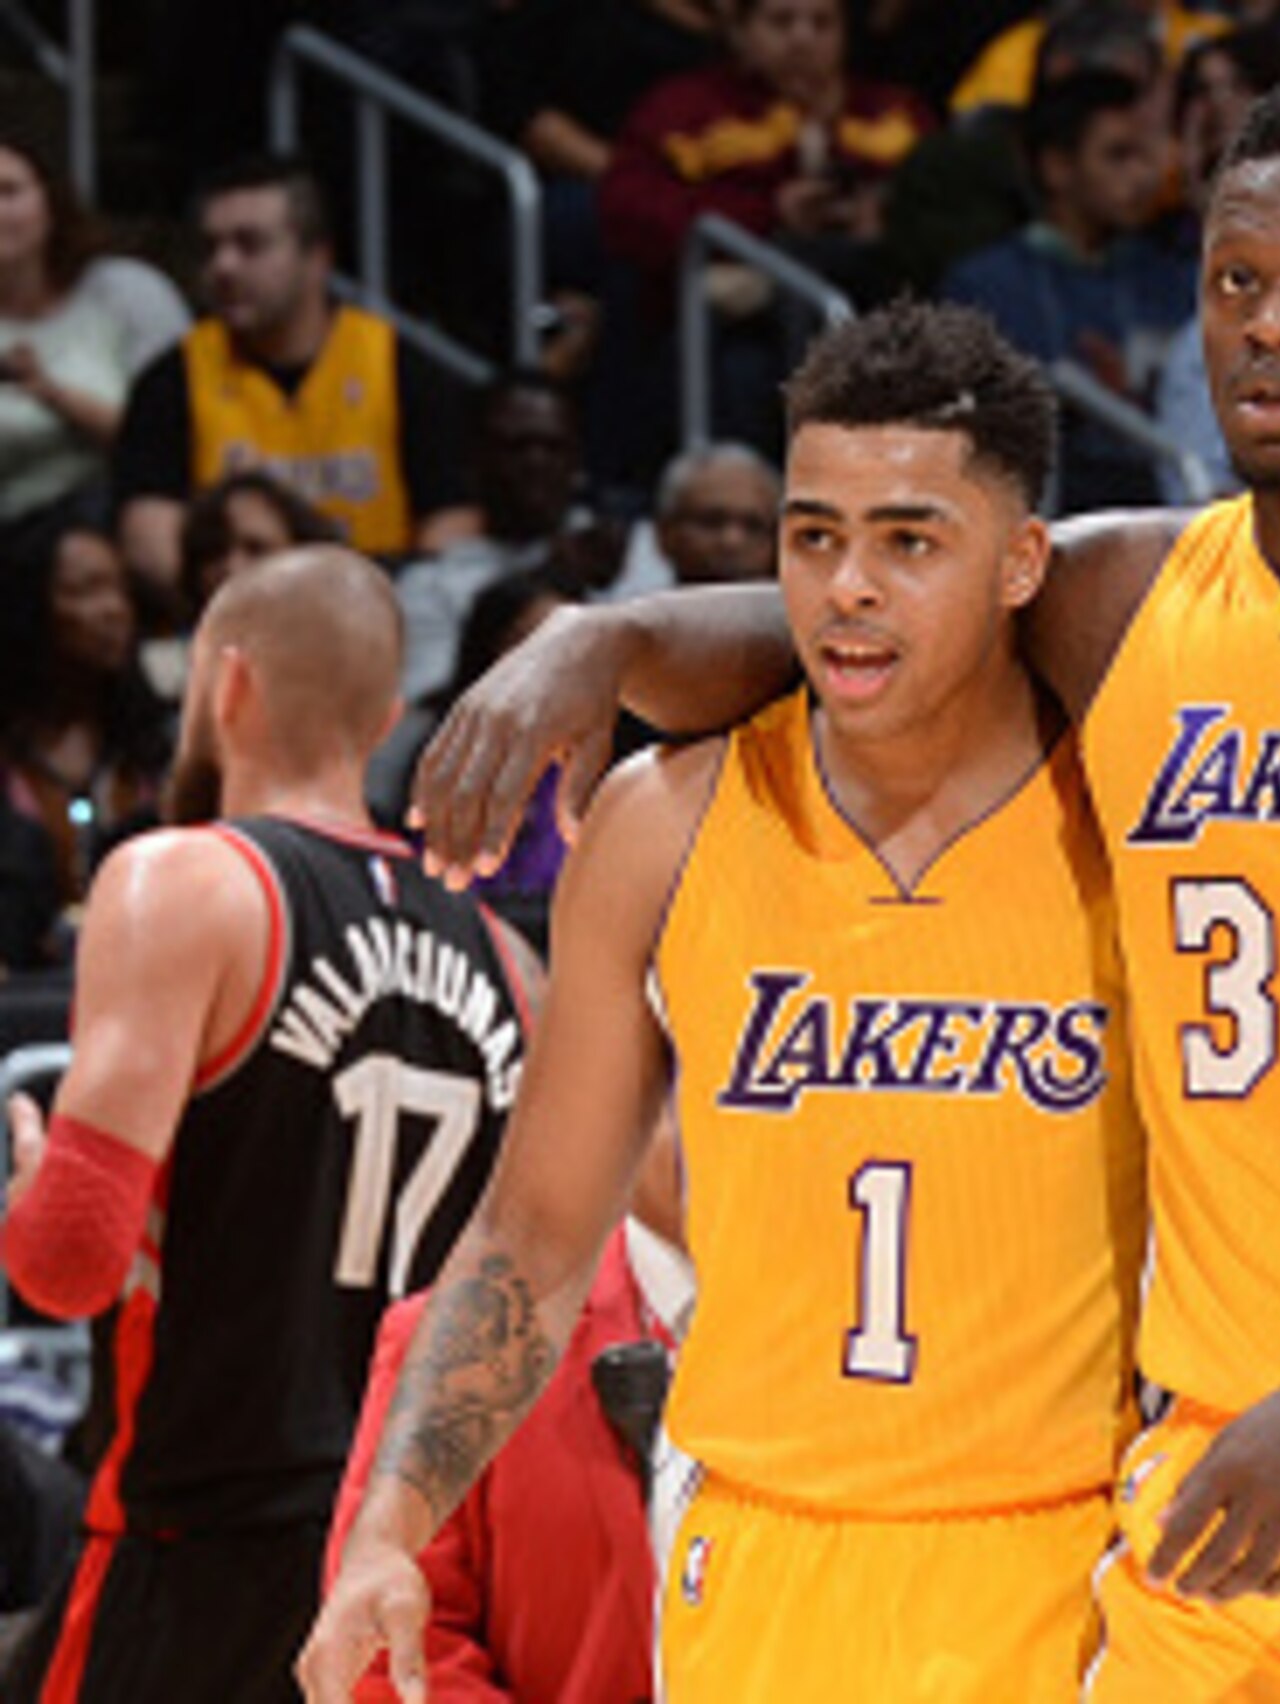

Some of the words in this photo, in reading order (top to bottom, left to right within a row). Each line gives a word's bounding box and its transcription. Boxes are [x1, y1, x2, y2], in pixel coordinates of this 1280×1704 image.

[716, 968, 1112, 1114] LAKERS
[332, 1052, 482, 1298] 17
[841, 1154, 919, 1385] 1
